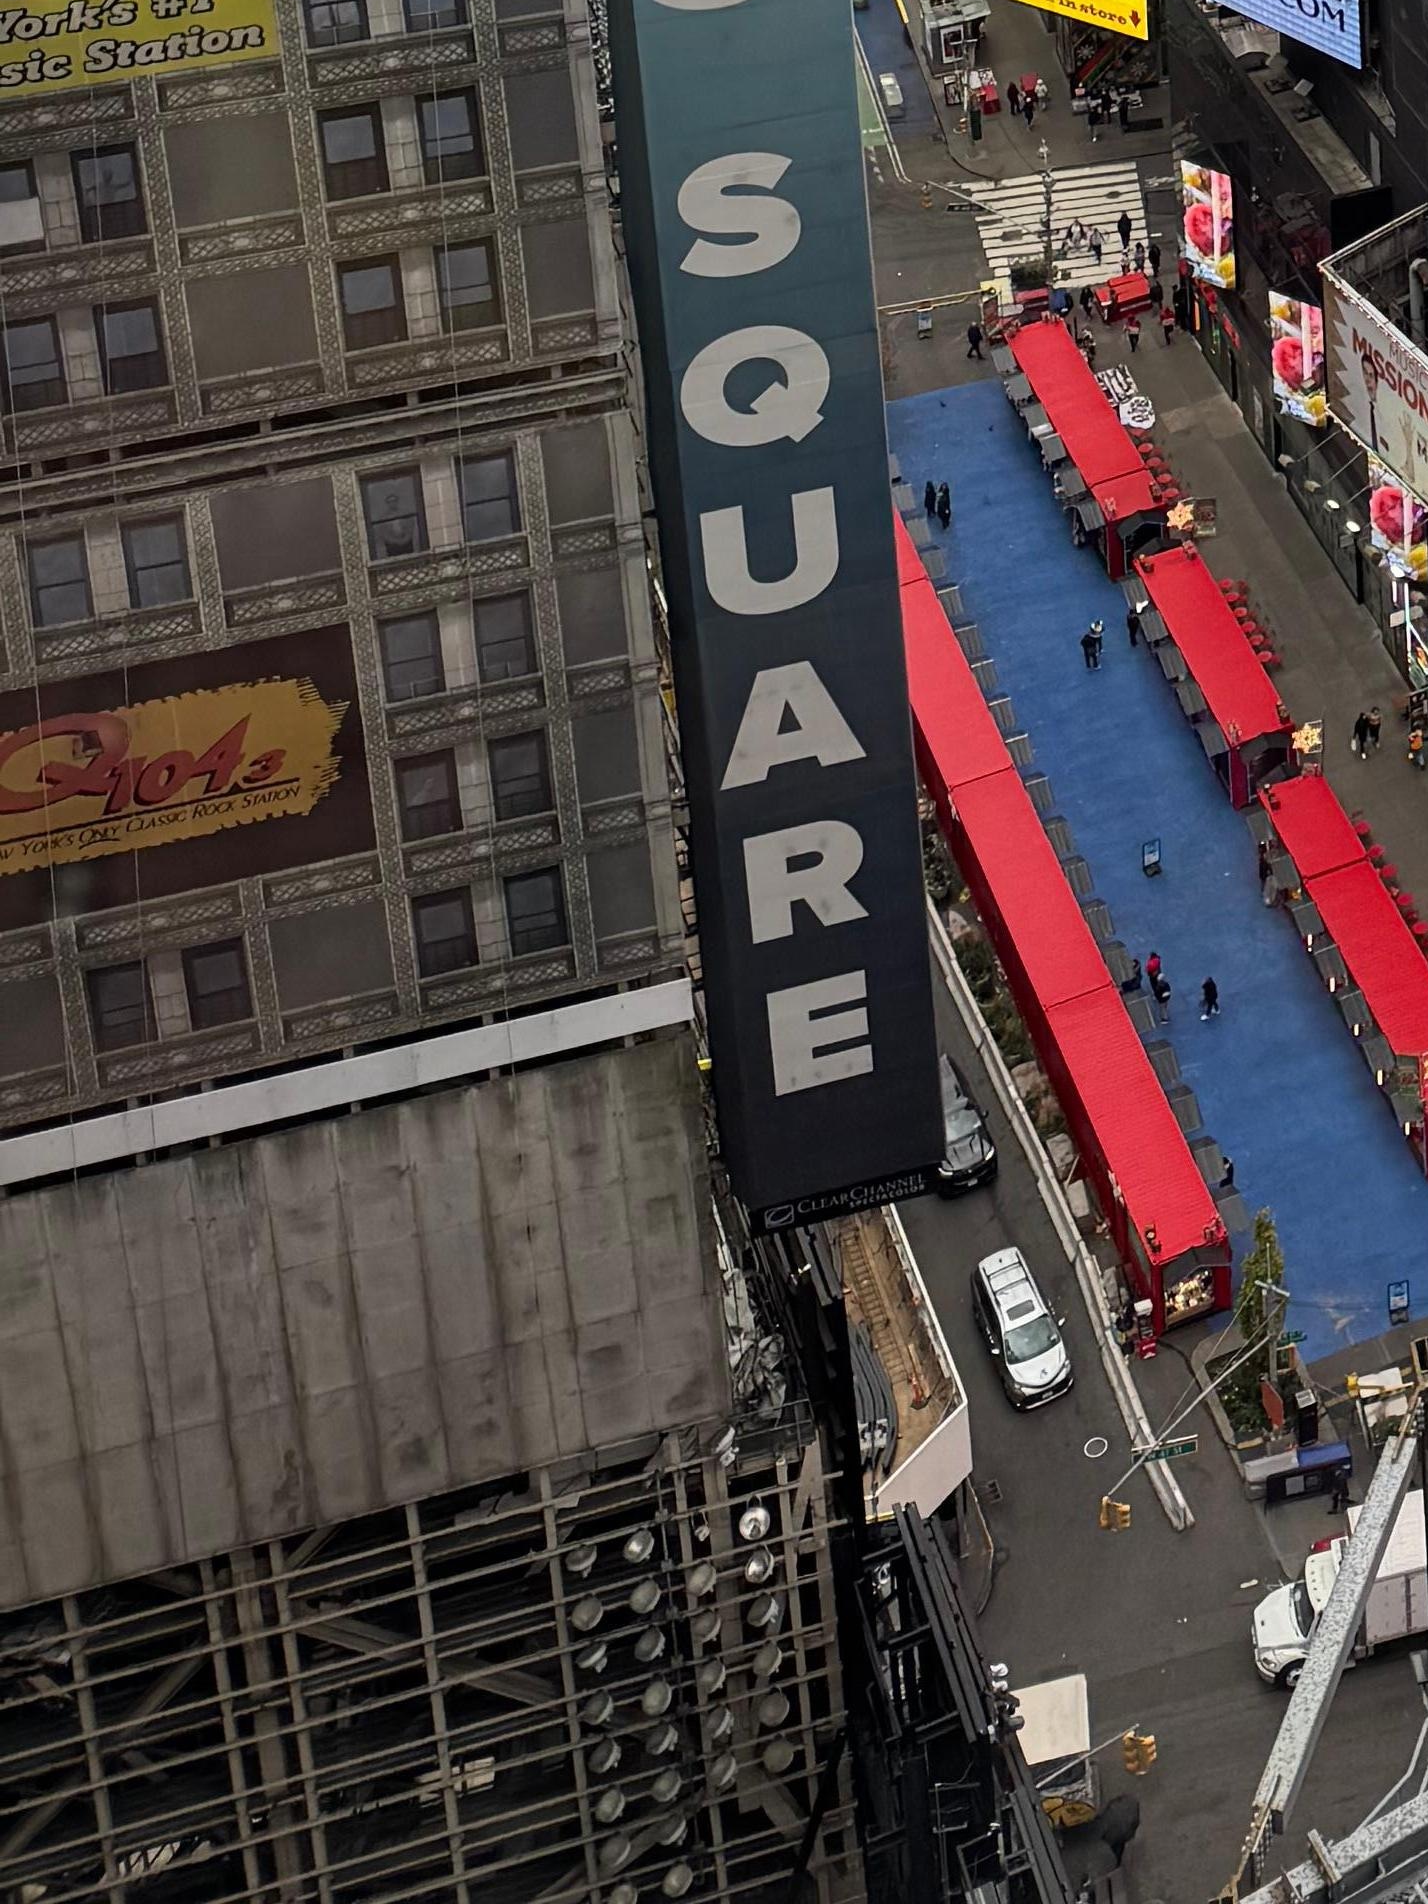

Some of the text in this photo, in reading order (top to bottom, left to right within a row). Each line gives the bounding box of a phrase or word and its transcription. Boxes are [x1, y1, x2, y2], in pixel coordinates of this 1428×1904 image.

[1079, 2, 1127, 25] store
[84, 25, 265, 73] Station
[679, 150, 874, 1096] SQUARE
[126, 809, 187, 833] CLASSIC
[192, 799, 235, 821] ROCK
[242, 785, 301, 810] STATION
